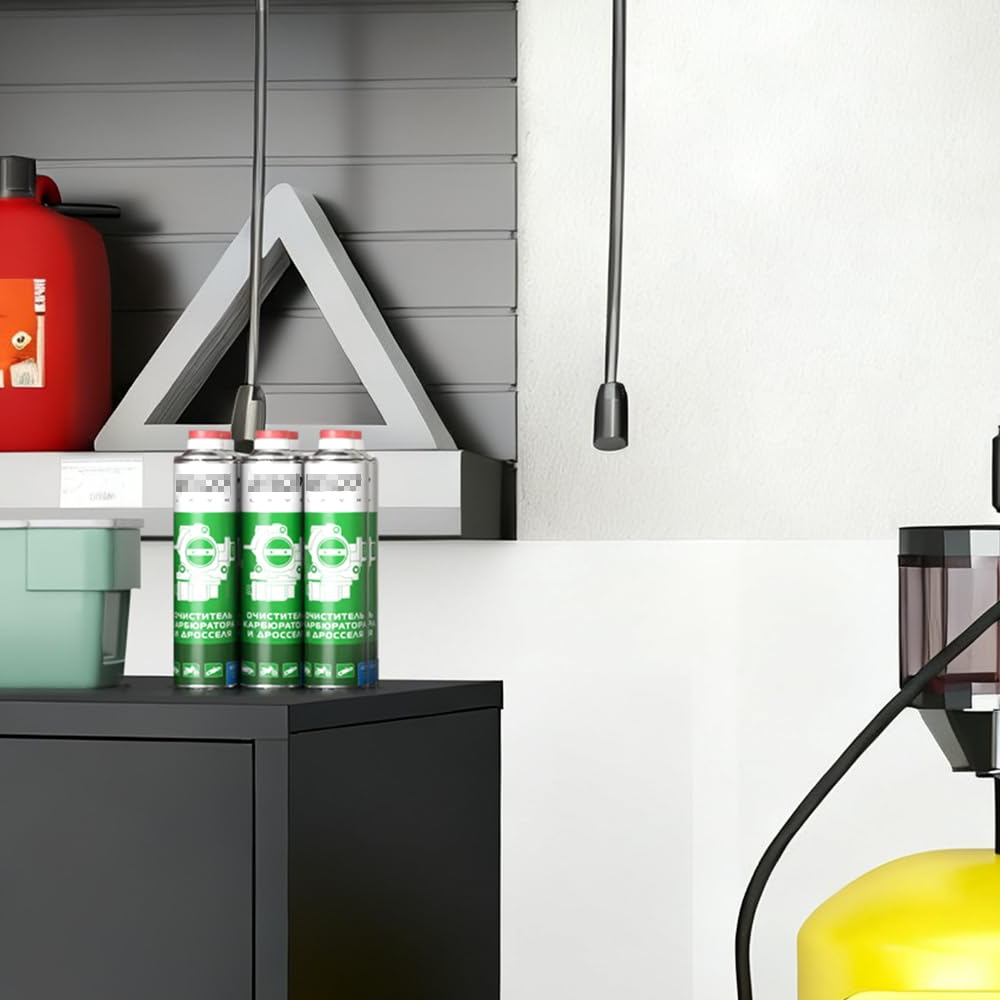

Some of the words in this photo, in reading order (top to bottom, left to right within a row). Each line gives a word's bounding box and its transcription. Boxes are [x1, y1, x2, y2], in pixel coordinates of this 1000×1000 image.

[246, 611, 301, 620] ОЧИСТИТЕ
[243, 621, 301, 629] КАРБЮРАТО
[257, 630, 301, 639] ДРОССЕ
